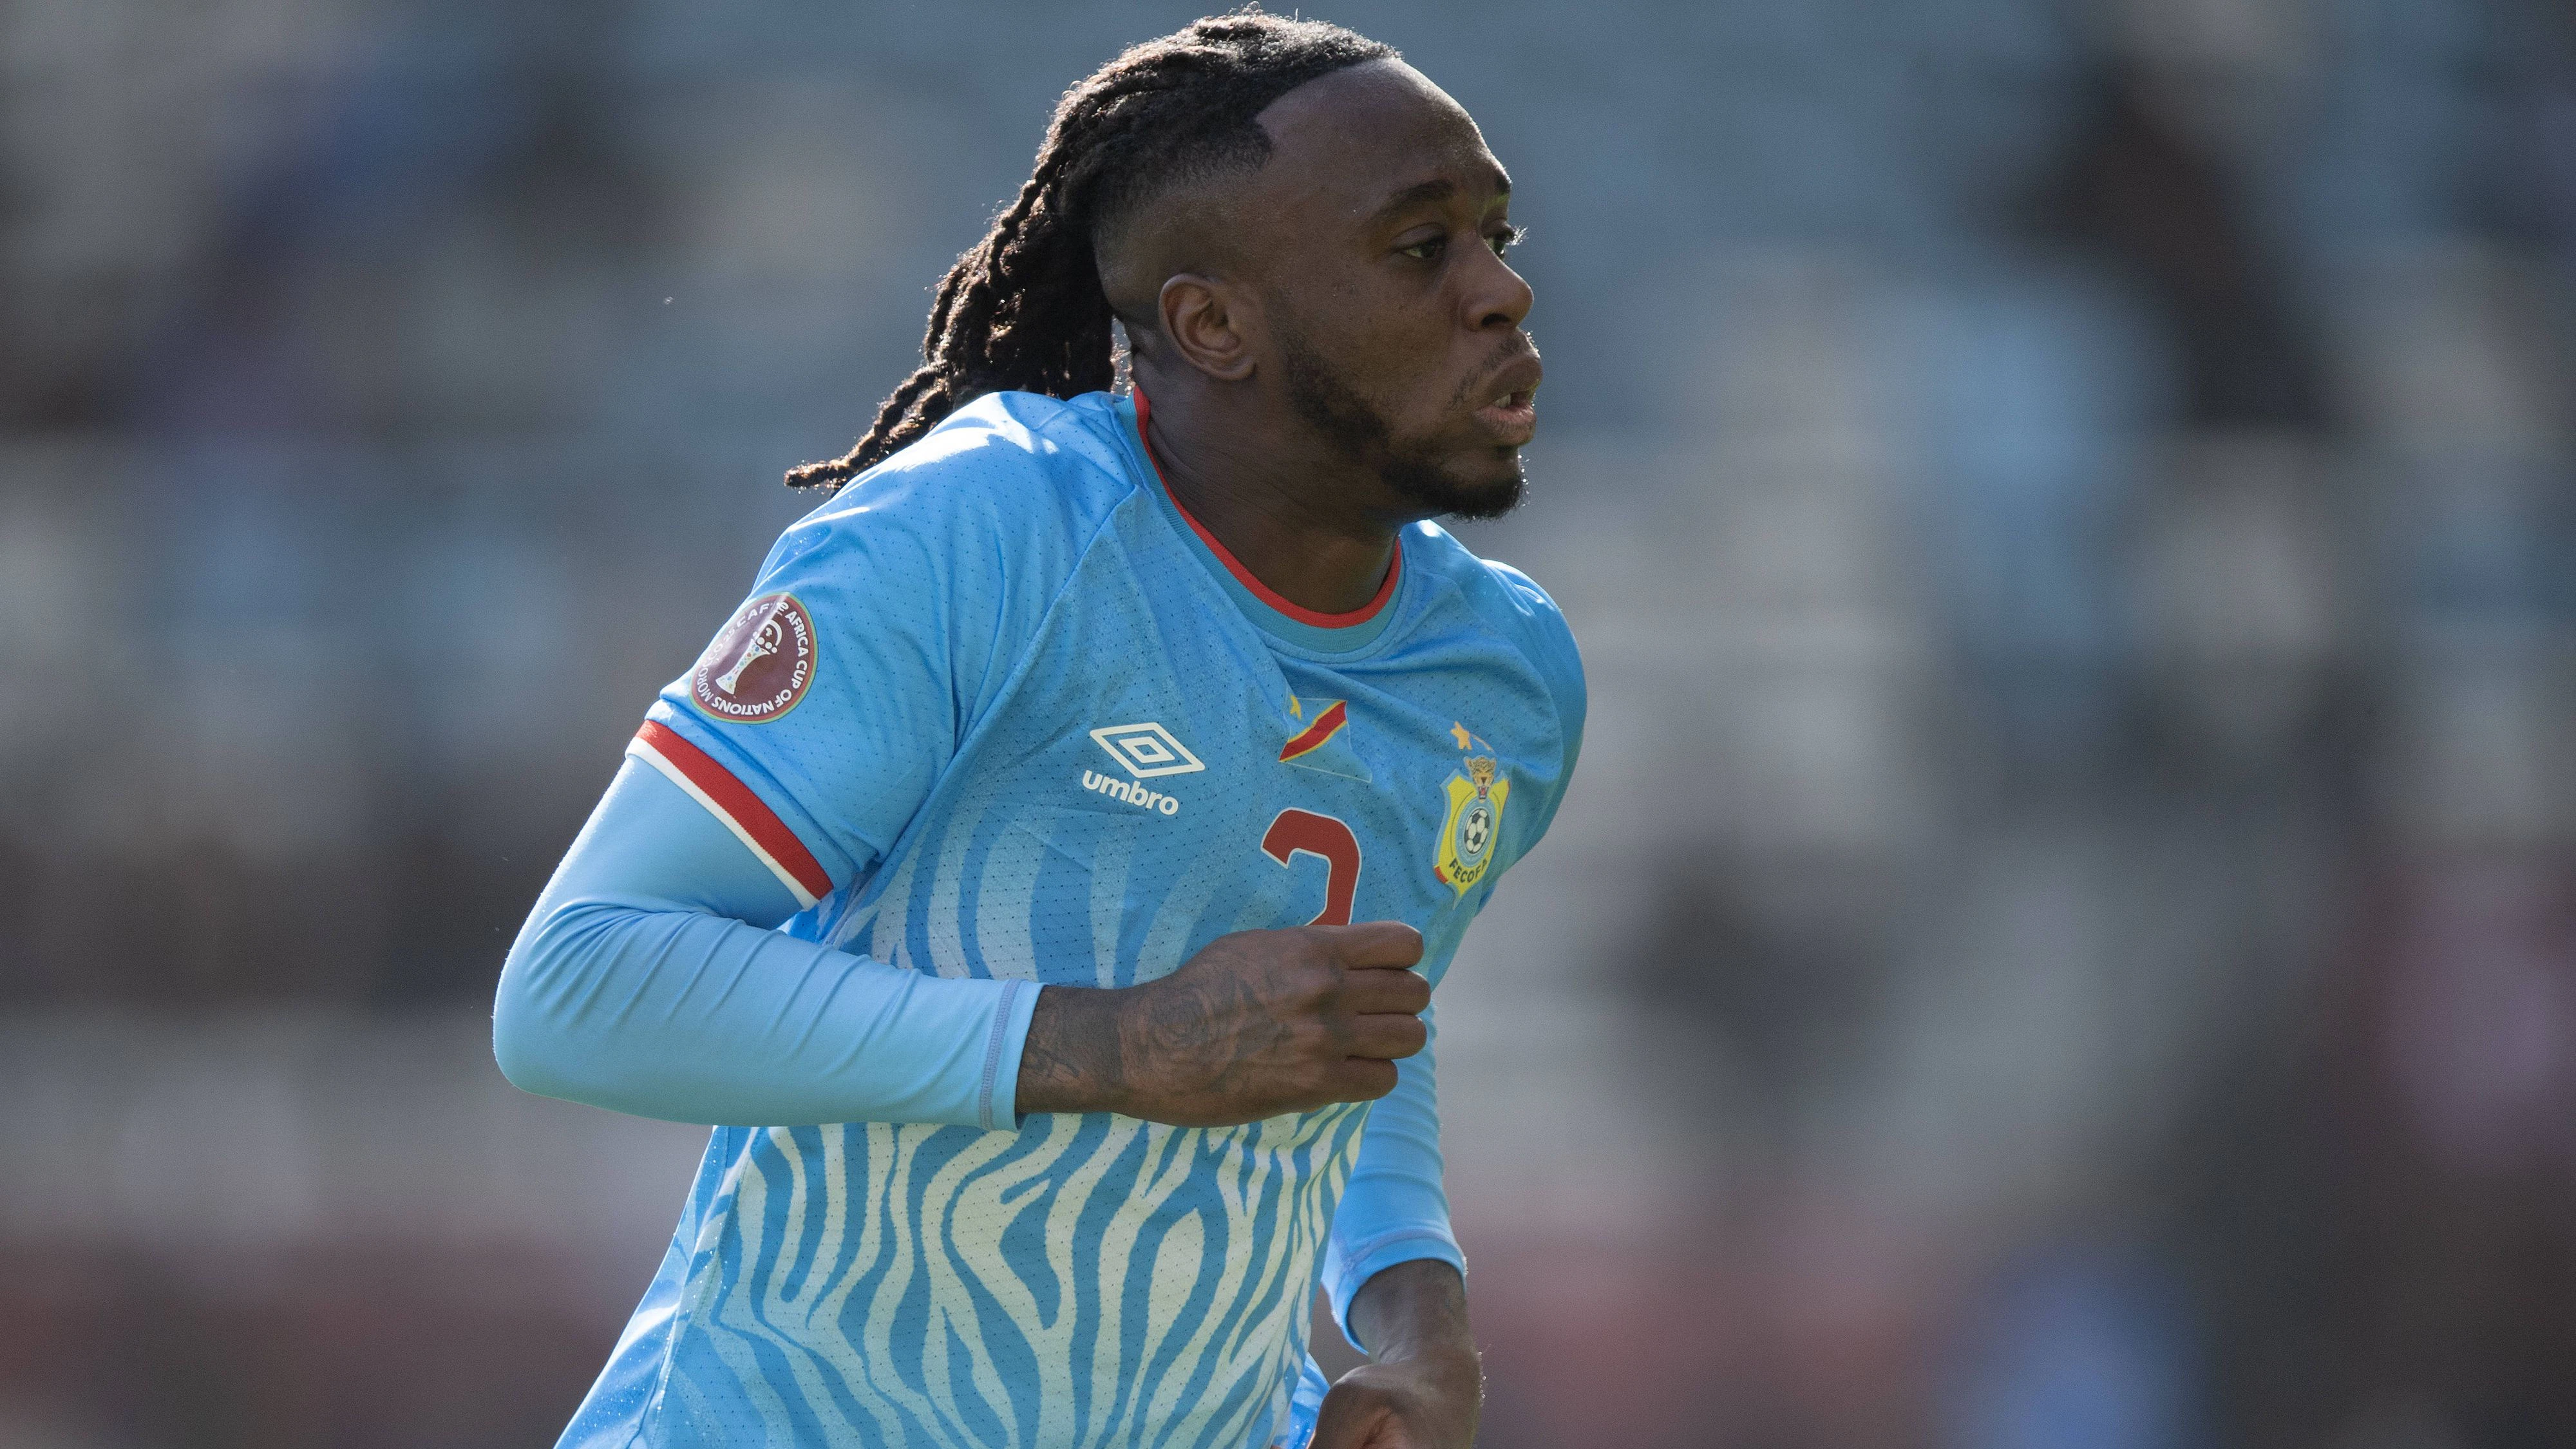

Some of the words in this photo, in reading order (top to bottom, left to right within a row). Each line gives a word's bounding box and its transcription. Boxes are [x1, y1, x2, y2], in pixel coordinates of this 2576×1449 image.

[736, 603, 770, 628] CAF
[784, 611, 809, 657] AFRICA
[791, 660, 808, 689] CUP
[712, 696, 775, 715] NATIONS
[775, 689, 792, 708] OF
[1082, 770, 1179, 815] umbro
